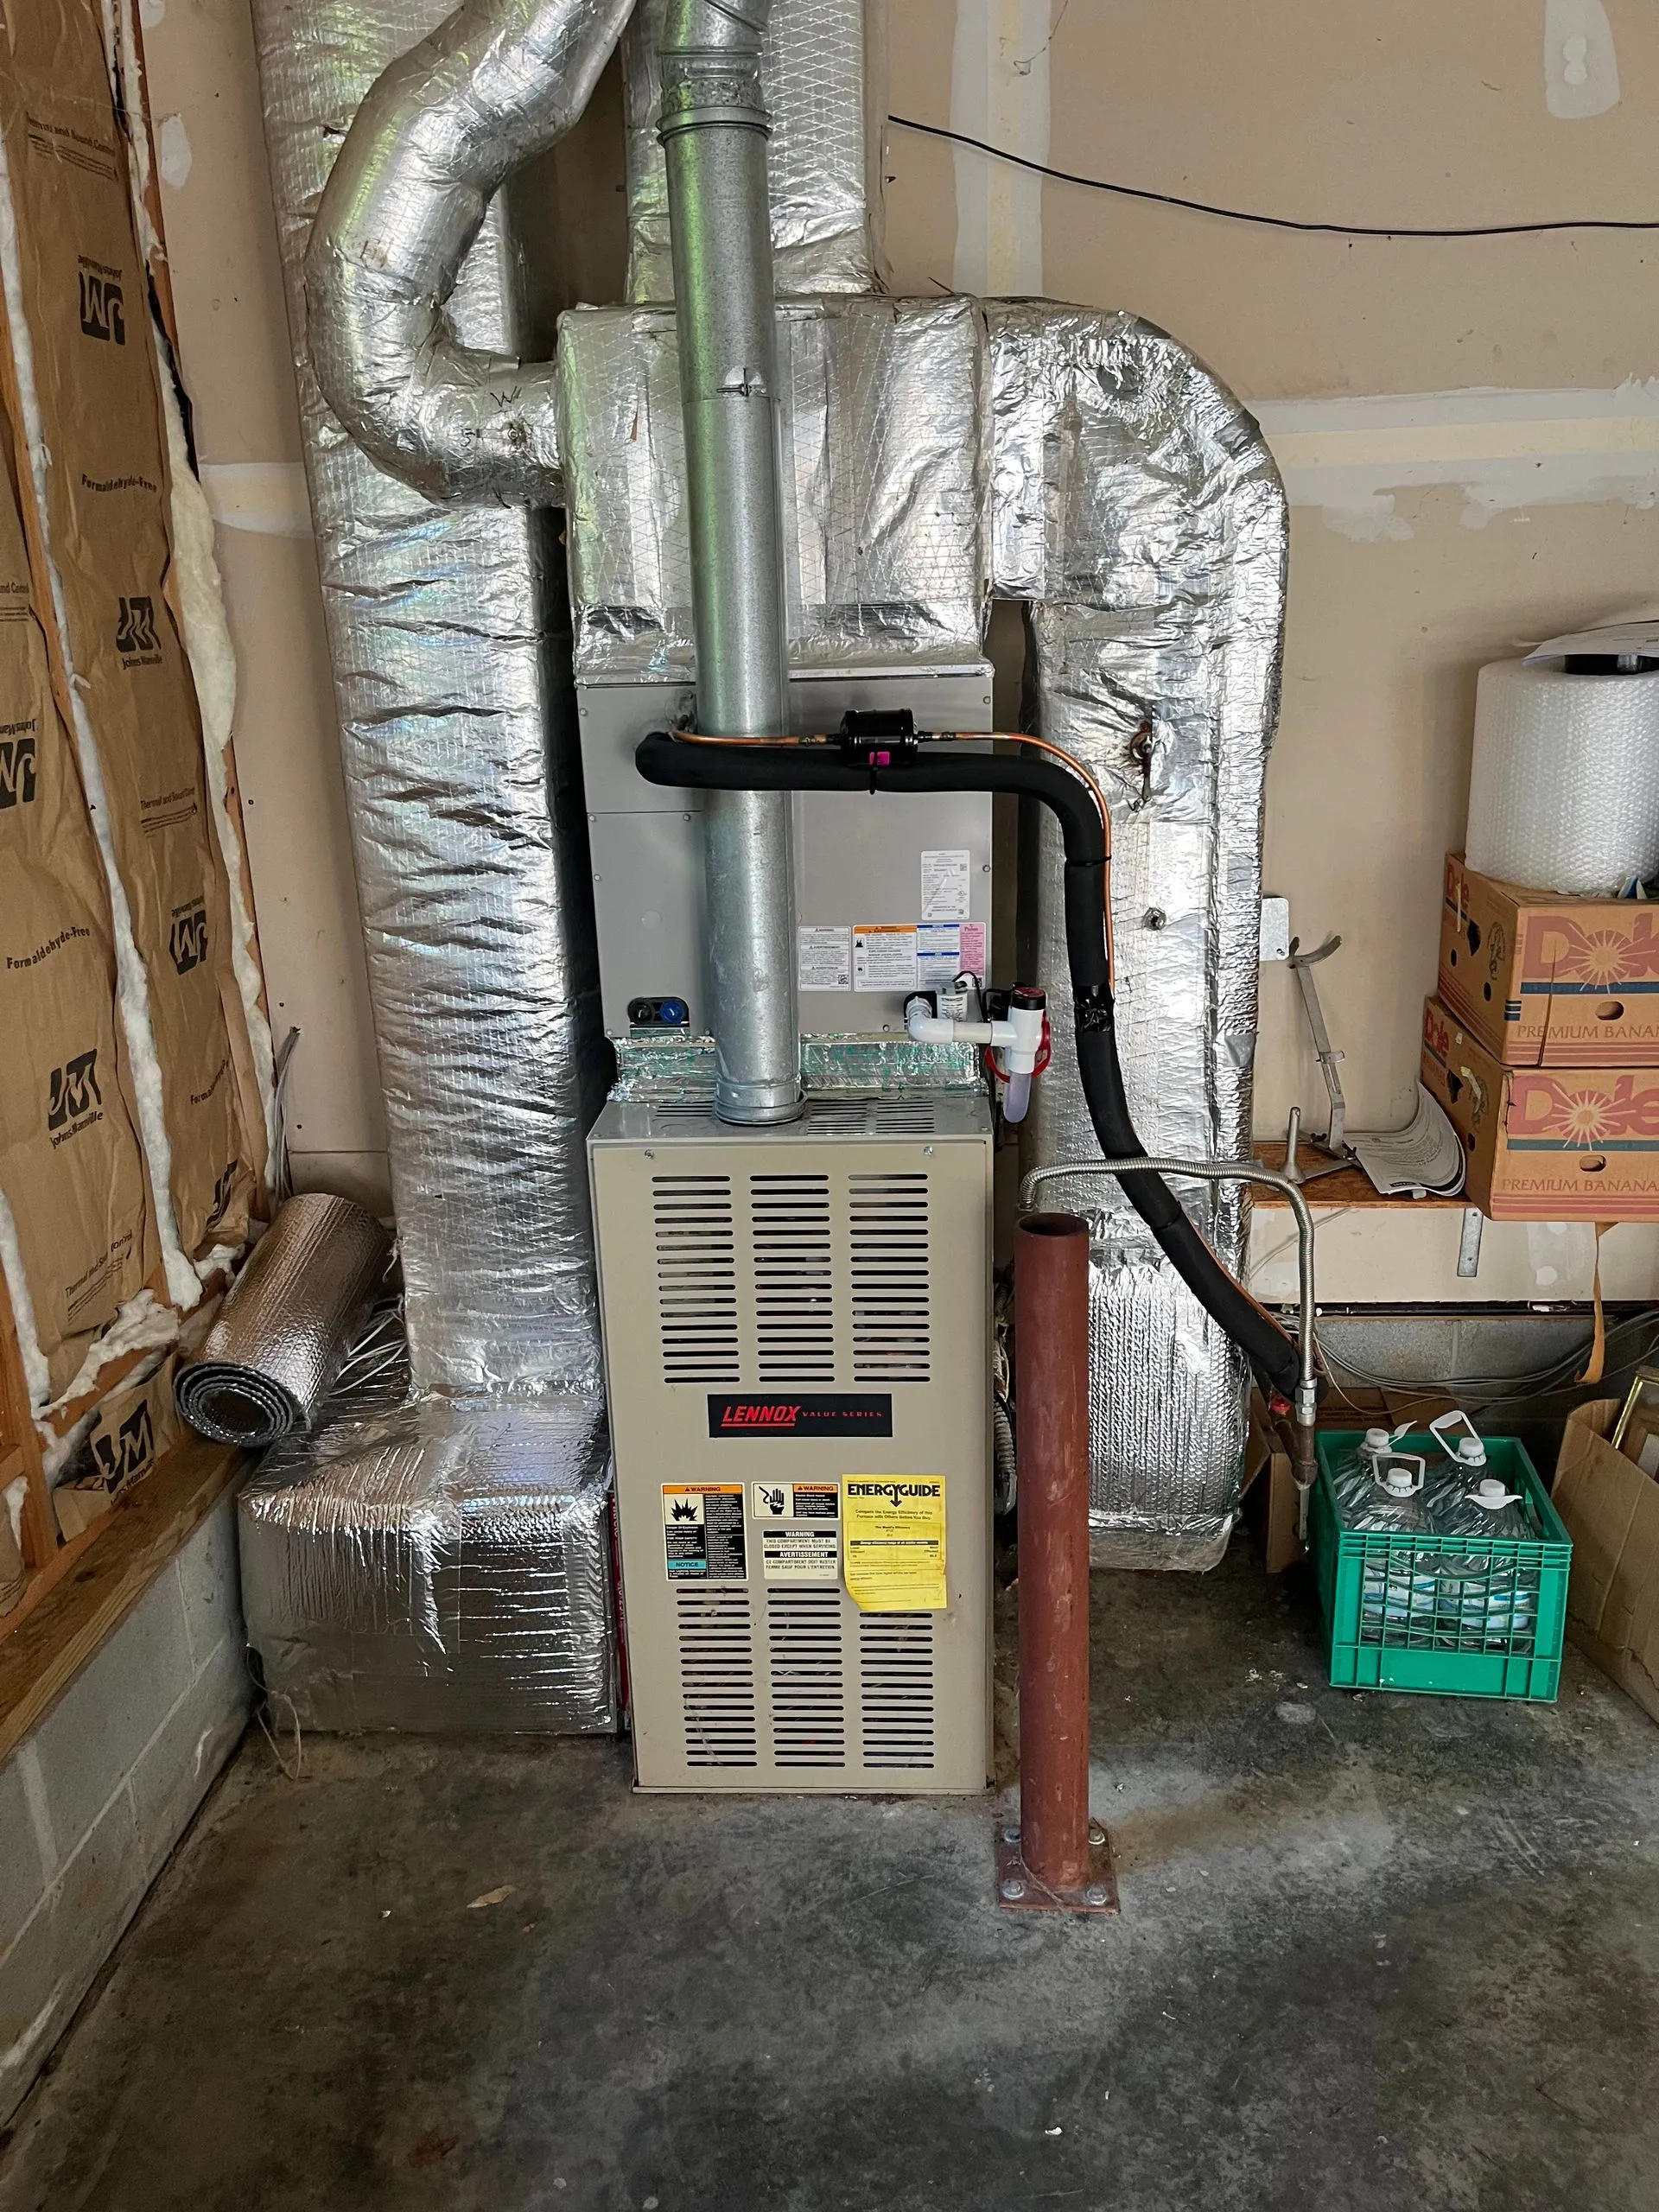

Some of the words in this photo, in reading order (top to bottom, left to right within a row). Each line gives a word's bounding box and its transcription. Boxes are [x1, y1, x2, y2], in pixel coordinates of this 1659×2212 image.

[79, 270, 126, 346] JM
[115, 595, 162, 653] JM
[6, 926, 91, 969] Formaldehyde-Free
[169, 910, 208, 976] JM
[1516, 1024, 1599, 1039] PREMIUM
[48, 1048, 103, 1132] JM
[1502, 1179, 1579, 1192] PREMIUM
[722, 1405, 802, 1423] LENNOX
[847, 1483, 941, 1499] ENERGYGUIDE
